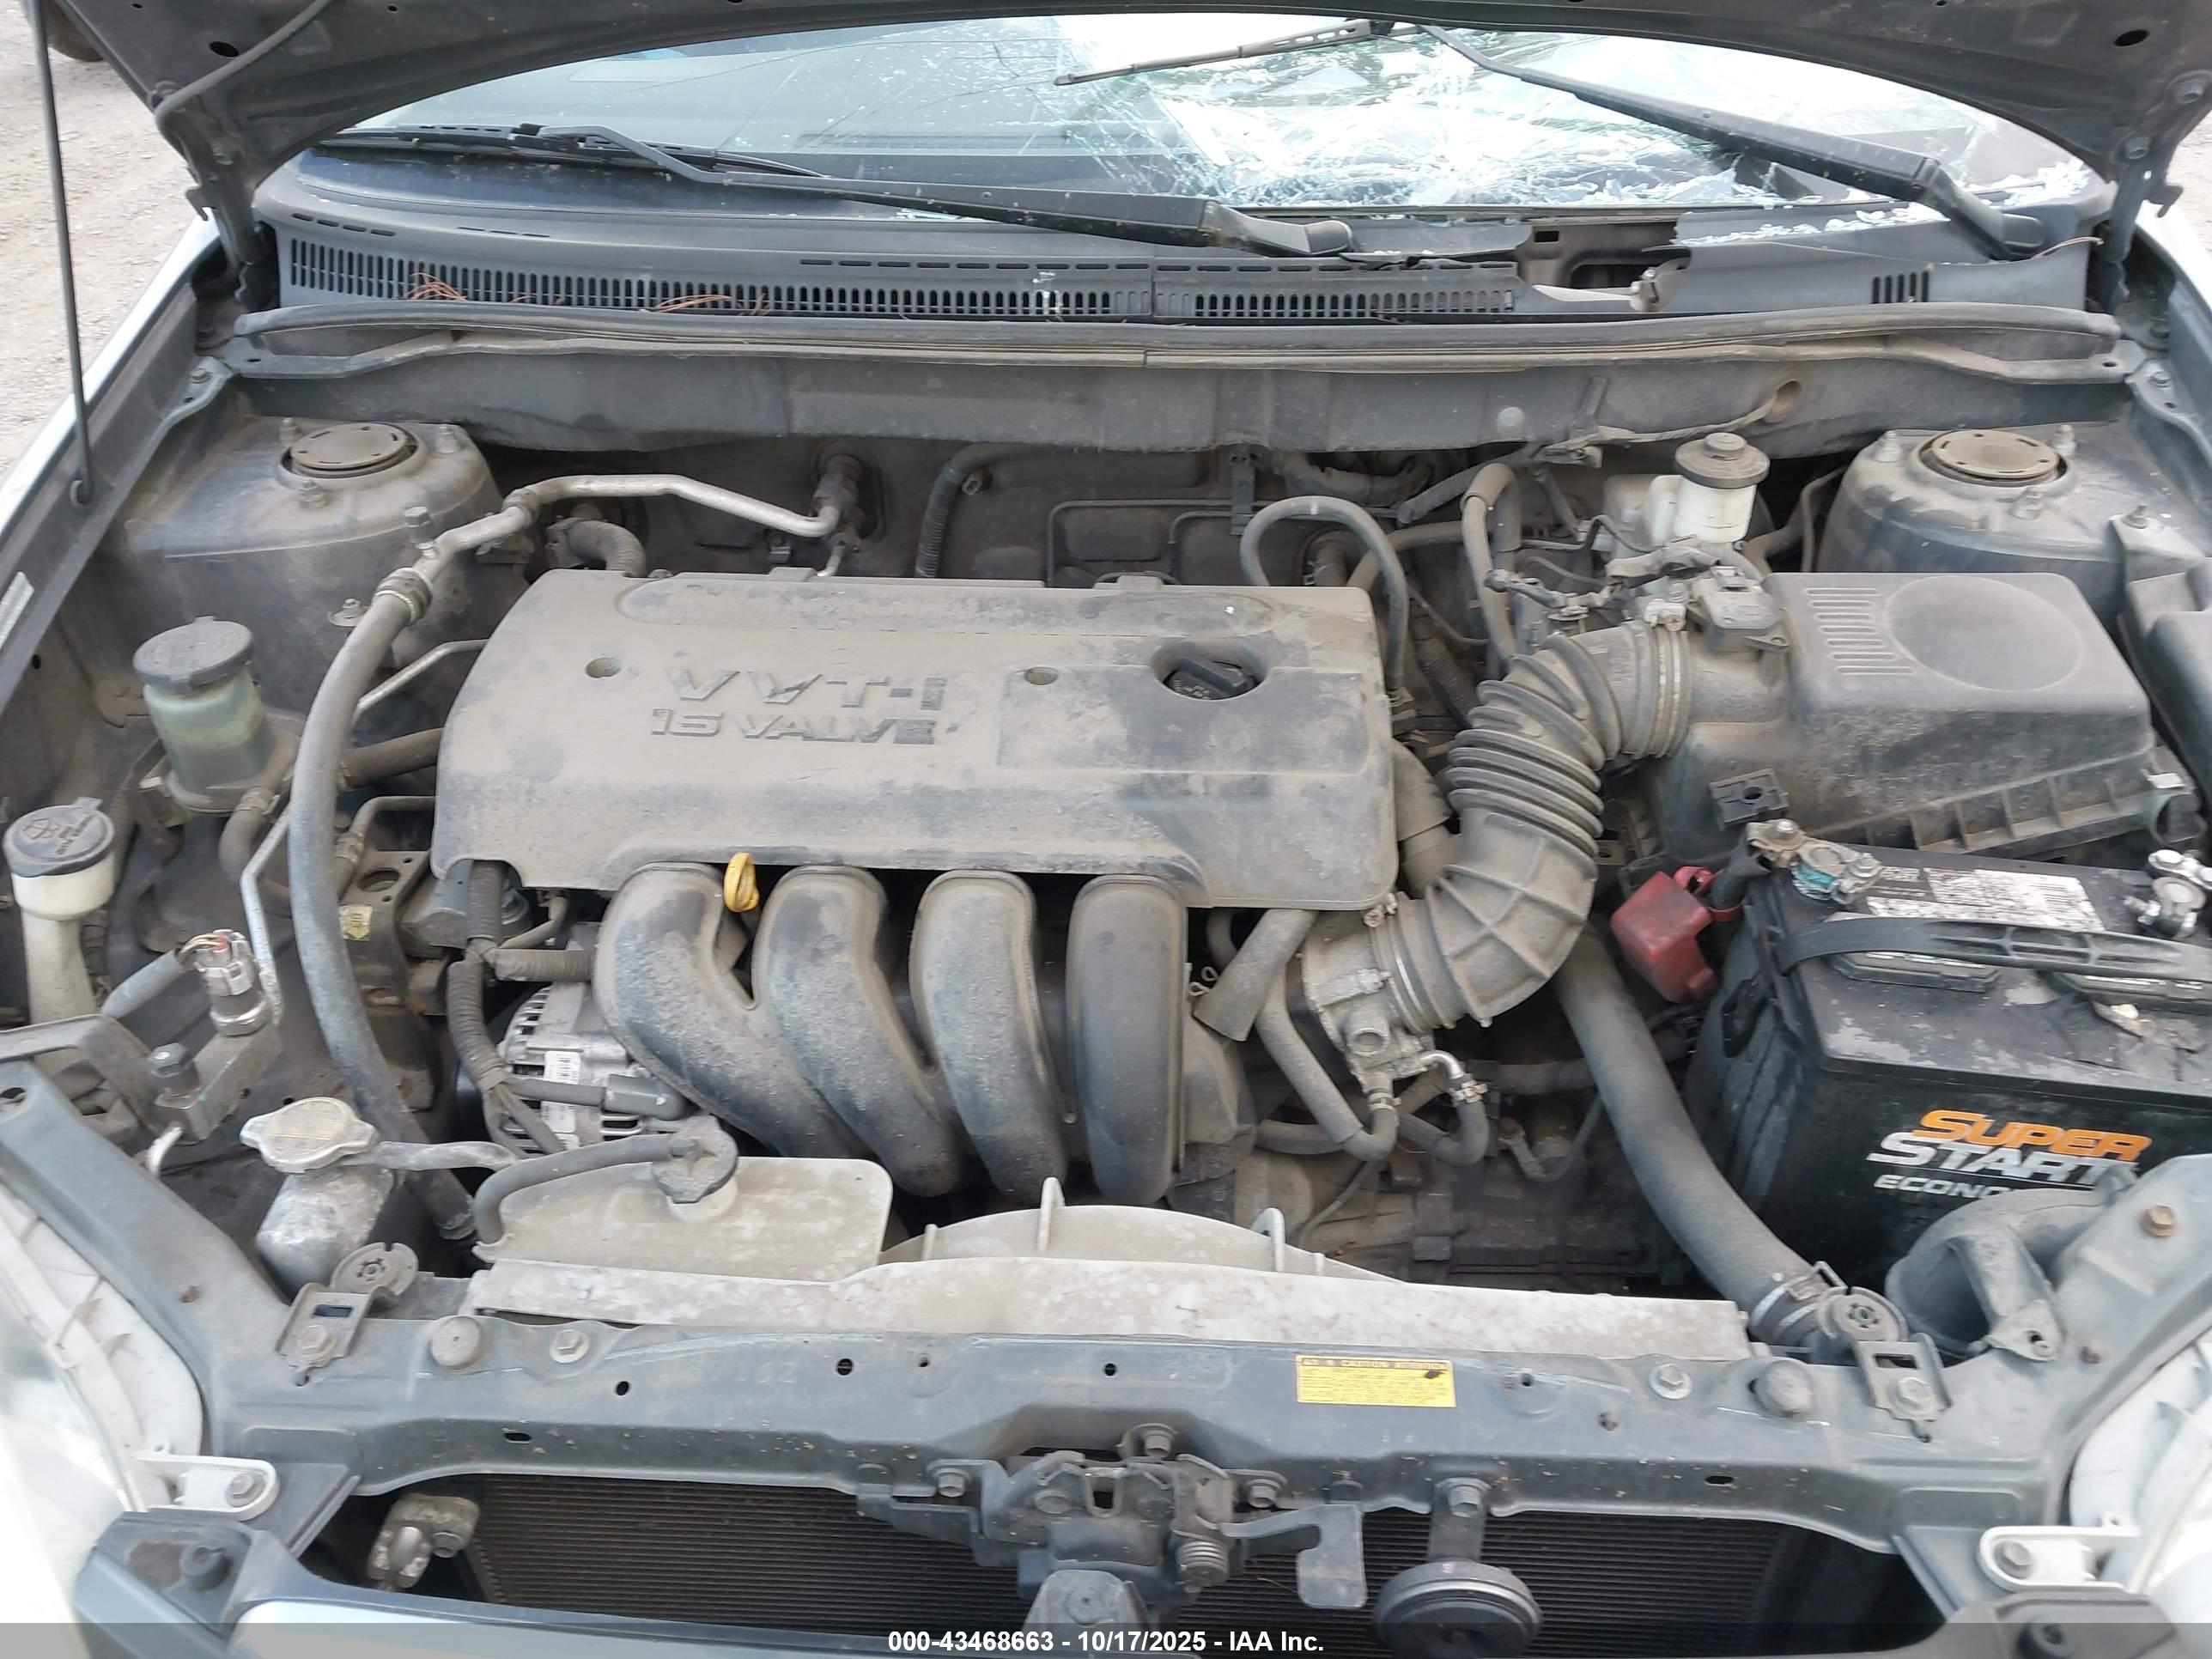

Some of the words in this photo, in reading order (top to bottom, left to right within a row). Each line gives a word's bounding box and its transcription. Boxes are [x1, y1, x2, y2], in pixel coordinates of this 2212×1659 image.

[650, 708, 724, 738] 16
[734, 713, 937, 745] VALVE
[1866, 1131, 2139, 1186] START
[1911, 1109, 2153, 1162] SUPER
